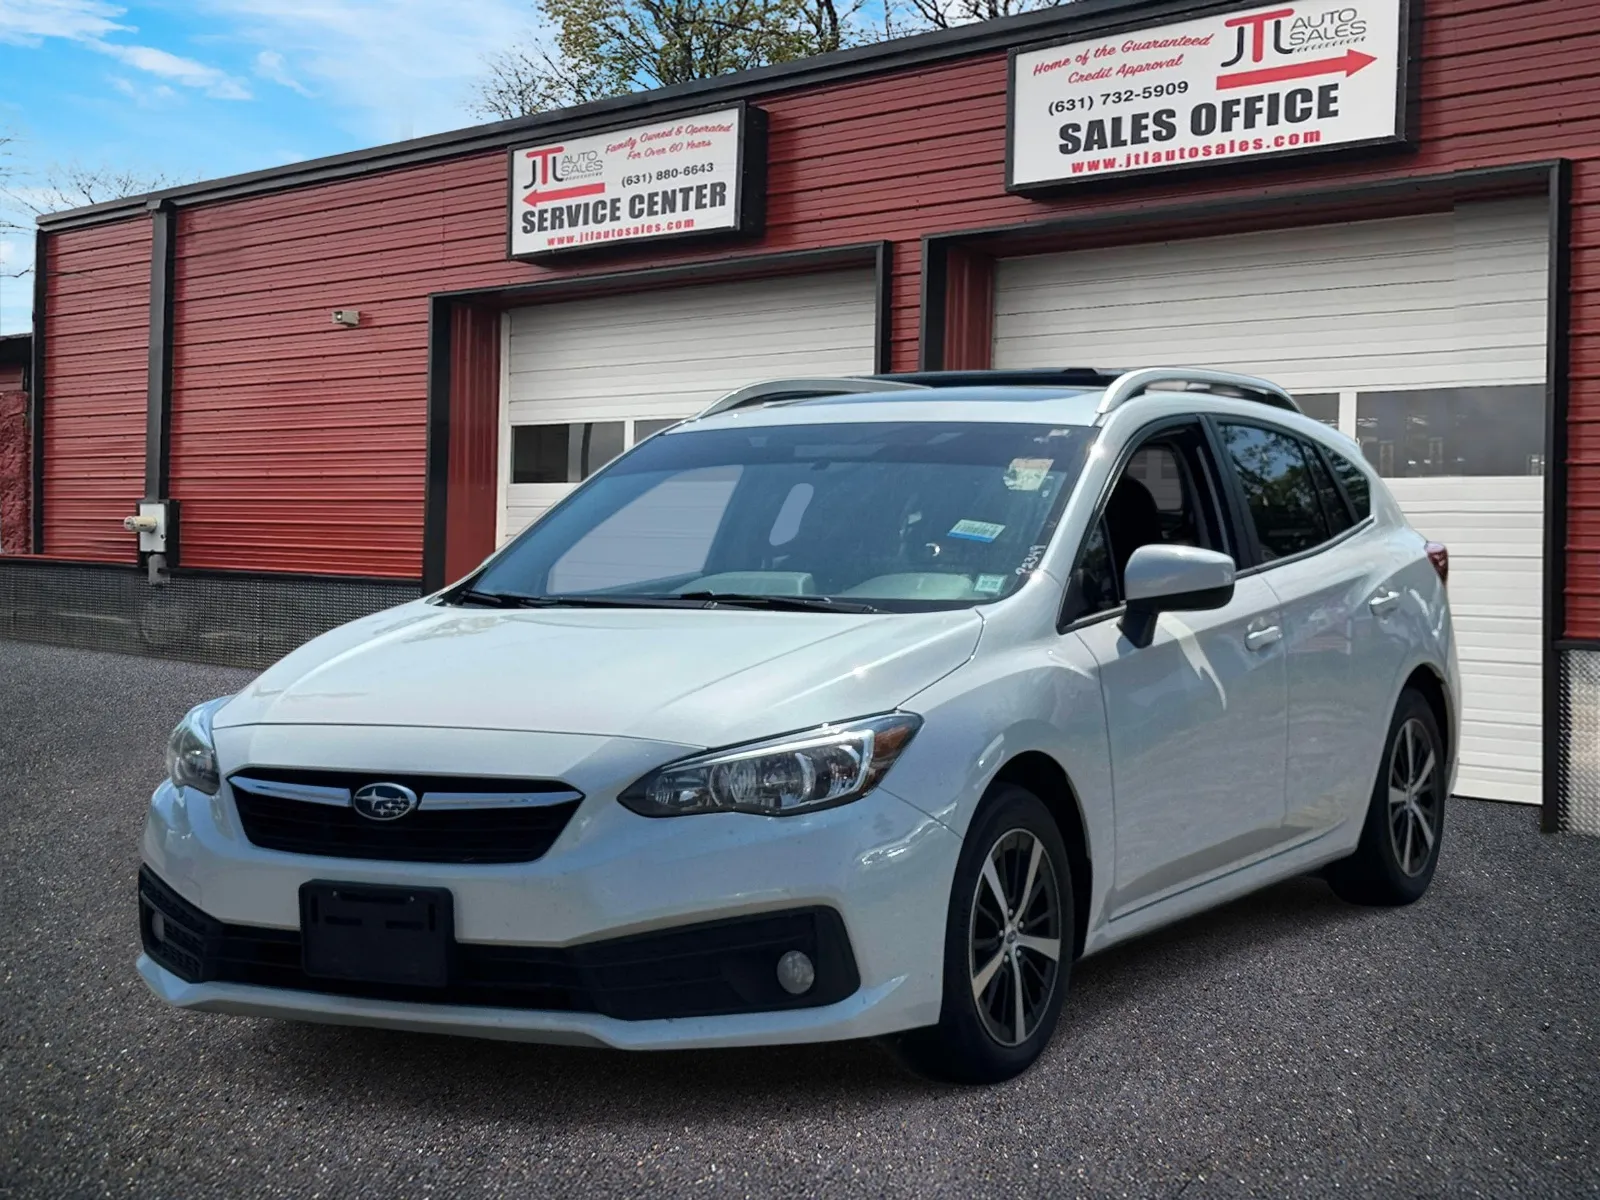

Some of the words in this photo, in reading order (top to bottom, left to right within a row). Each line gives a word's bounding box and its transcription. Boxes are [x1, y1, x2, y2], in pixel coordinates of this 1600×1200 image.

[1289, 20, 1367, 46] SALES
[1290, 7, 1357, 32] AUTO
[1220, 8, 1295, 68] JTL
[1033, 54, 1072, 76] Home
[1075, 49, 1091, 67] of
[1094, 43, 1117, 58] the
[1121, 33, 1215, 54] Guaranteed
[1067, 66, 1113, 85] Credit
[1115, 53, 1184, 77] Approval
[1048, 95, 1094, 116] (631)
[1100, 81, 1189, 106] 732-5909
[1058, 108, 1178, 155] SALES
[1189, 83, 1340, 137] OFFICE
[605, 137, 637, 155] Family
[640, 128, 673, 143] Owned
[675, 125, 684, 136] &
[685, 122, 734, 136] Operated
[627, 149, 641, 160] For
[644, 144, 667, 158] Over
[669, 143, 683, 154] 60
[686, 139, 712, 150] Years
[1071, 129, 1322, 174] www.jtlautosales.com
[523, 146, 565, 190] JTL
[560, 159, 604, 177] SALES
[561, 150, 598, 166] AUTO
[621, 171, 653, 188] (631)
[656, 162, 714, 181] 880-6643
[522, 197, 621, 234] SERVICE
[629, 181, 727, 219] CENTER
[547, 218, 695, 246] www.jtlautosales.com
